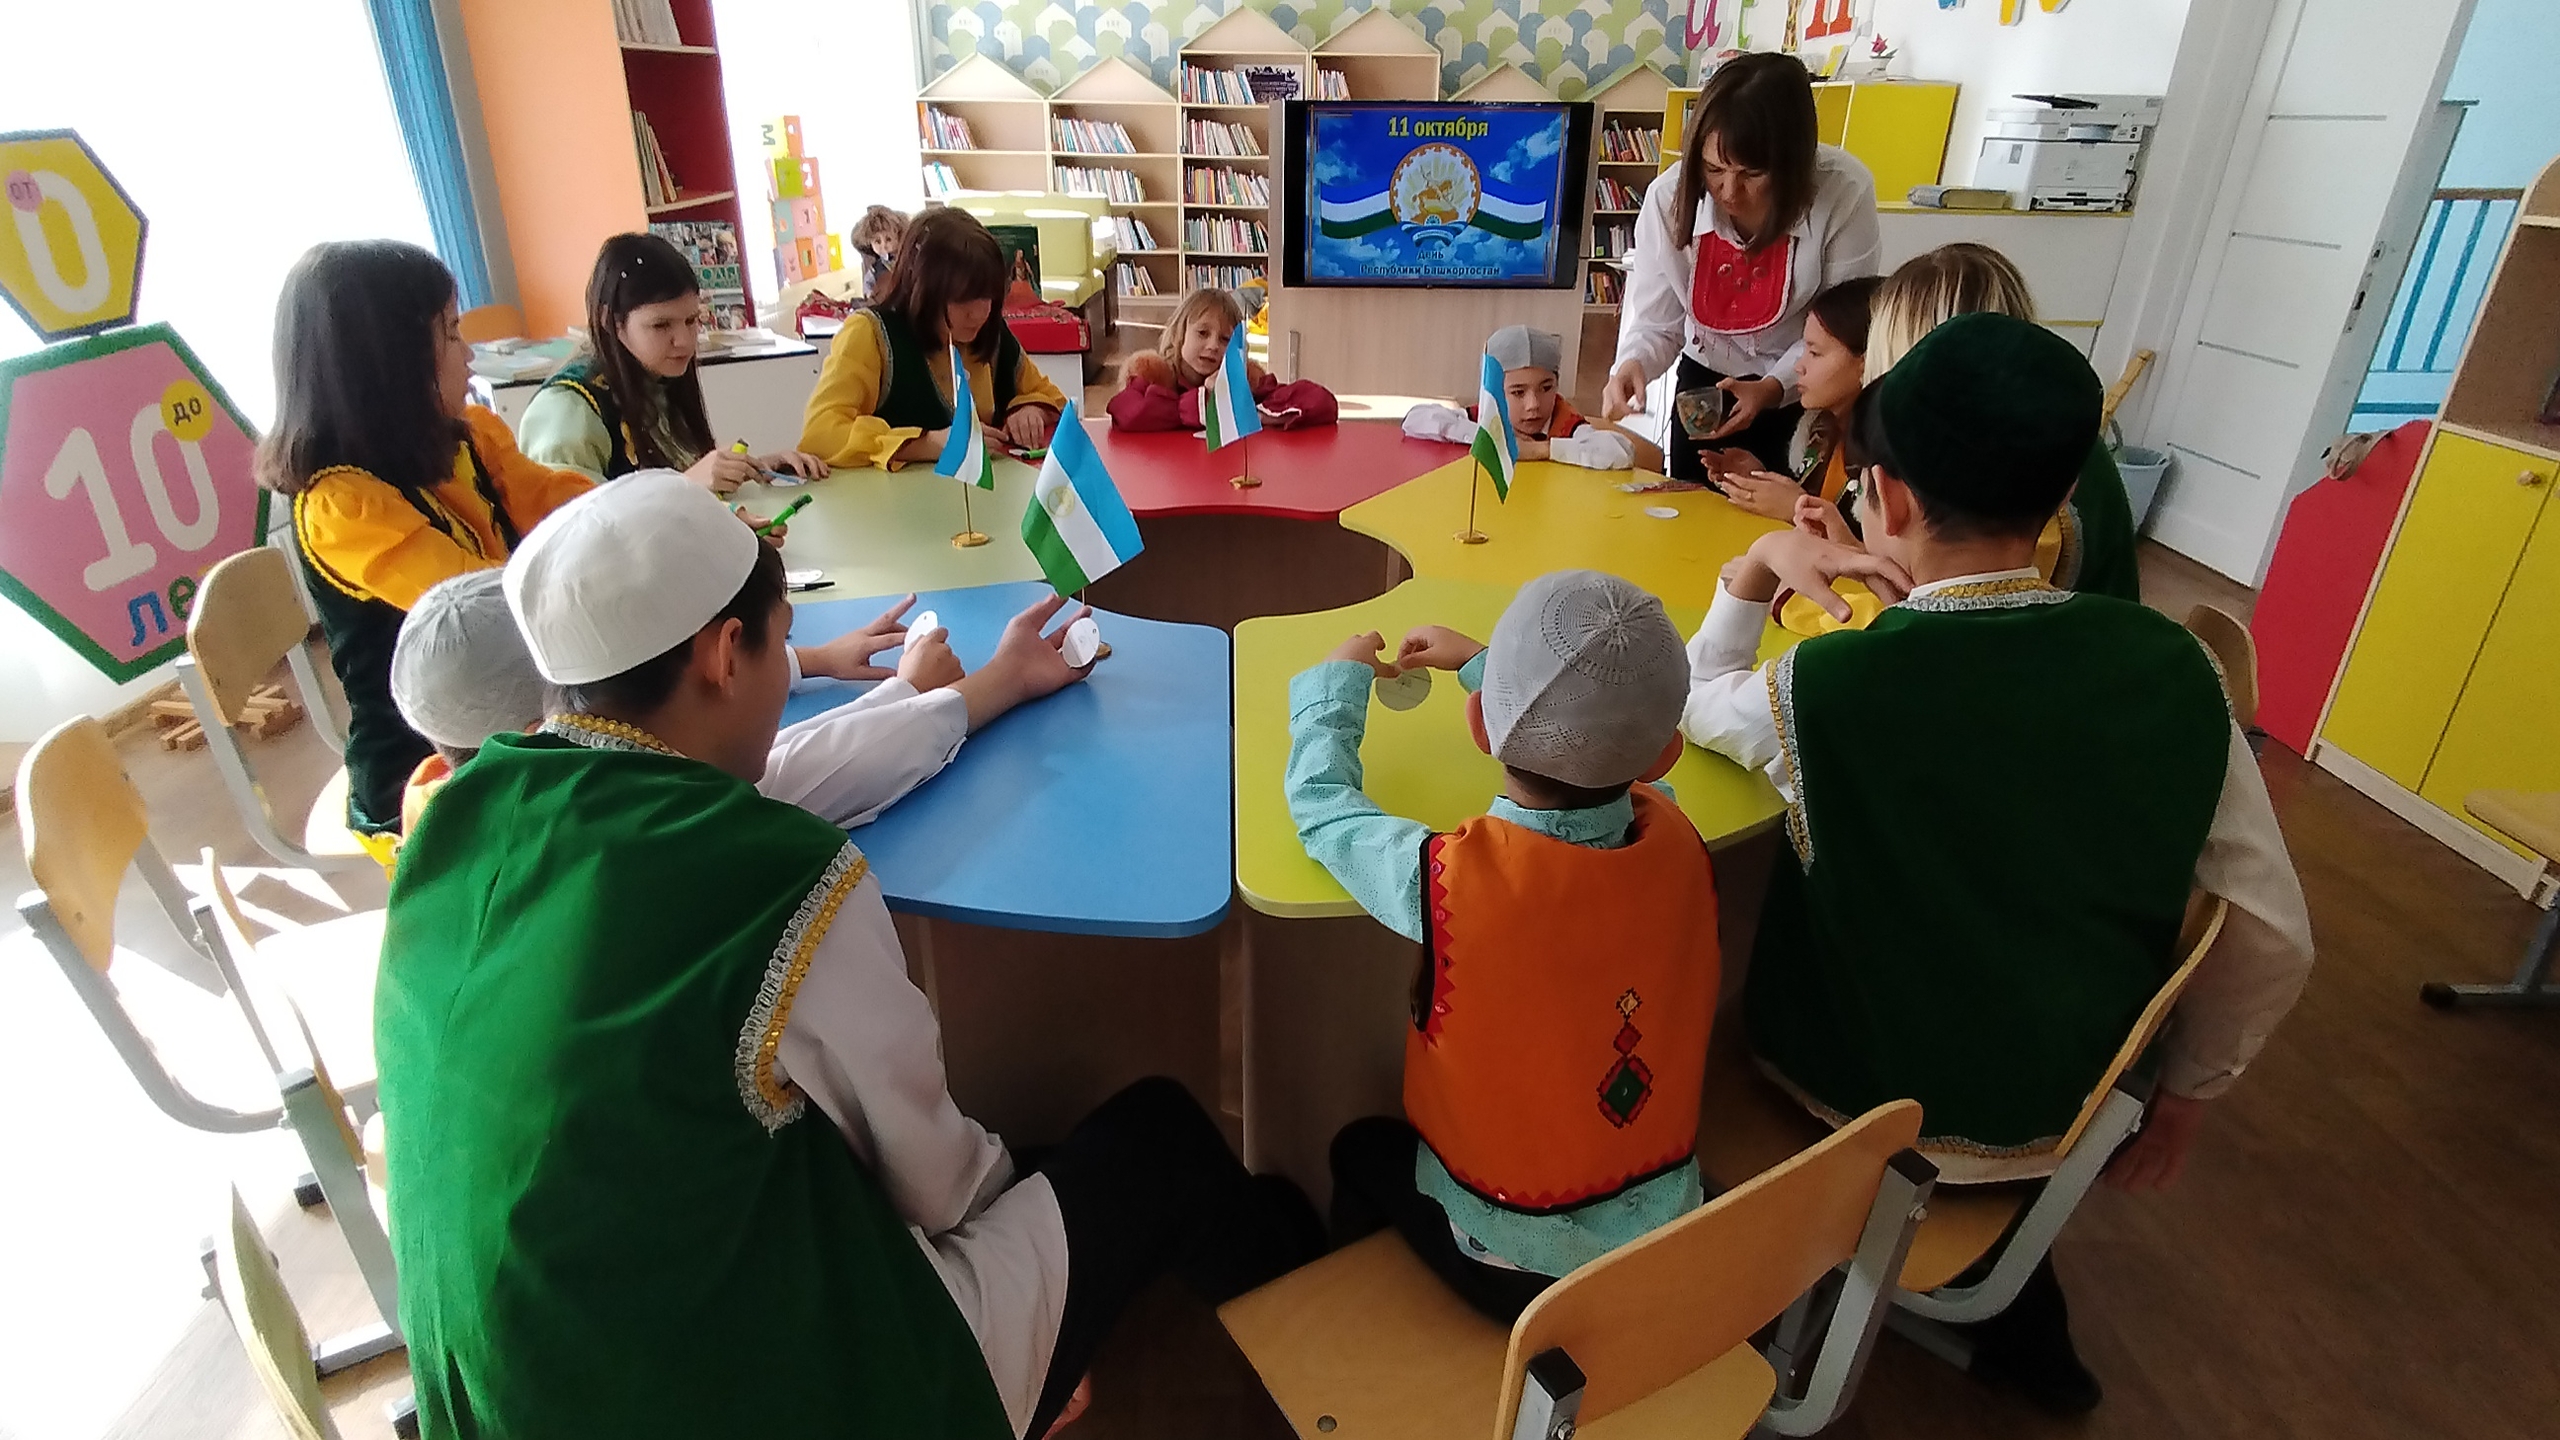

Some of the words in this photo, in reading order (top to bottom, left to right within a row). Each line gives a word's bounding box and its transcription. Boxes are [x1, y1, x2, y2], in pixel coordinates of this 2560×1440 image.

[1388, 116, 1410, 137] 11
[1413, 116, 1489, 141] октября
[13, 169, 111, 313] 0
[1424, 264, 1501, 276] Башкортостан
[45, 402, 220, 591] 10
[128, 565, 207, 647] ле
